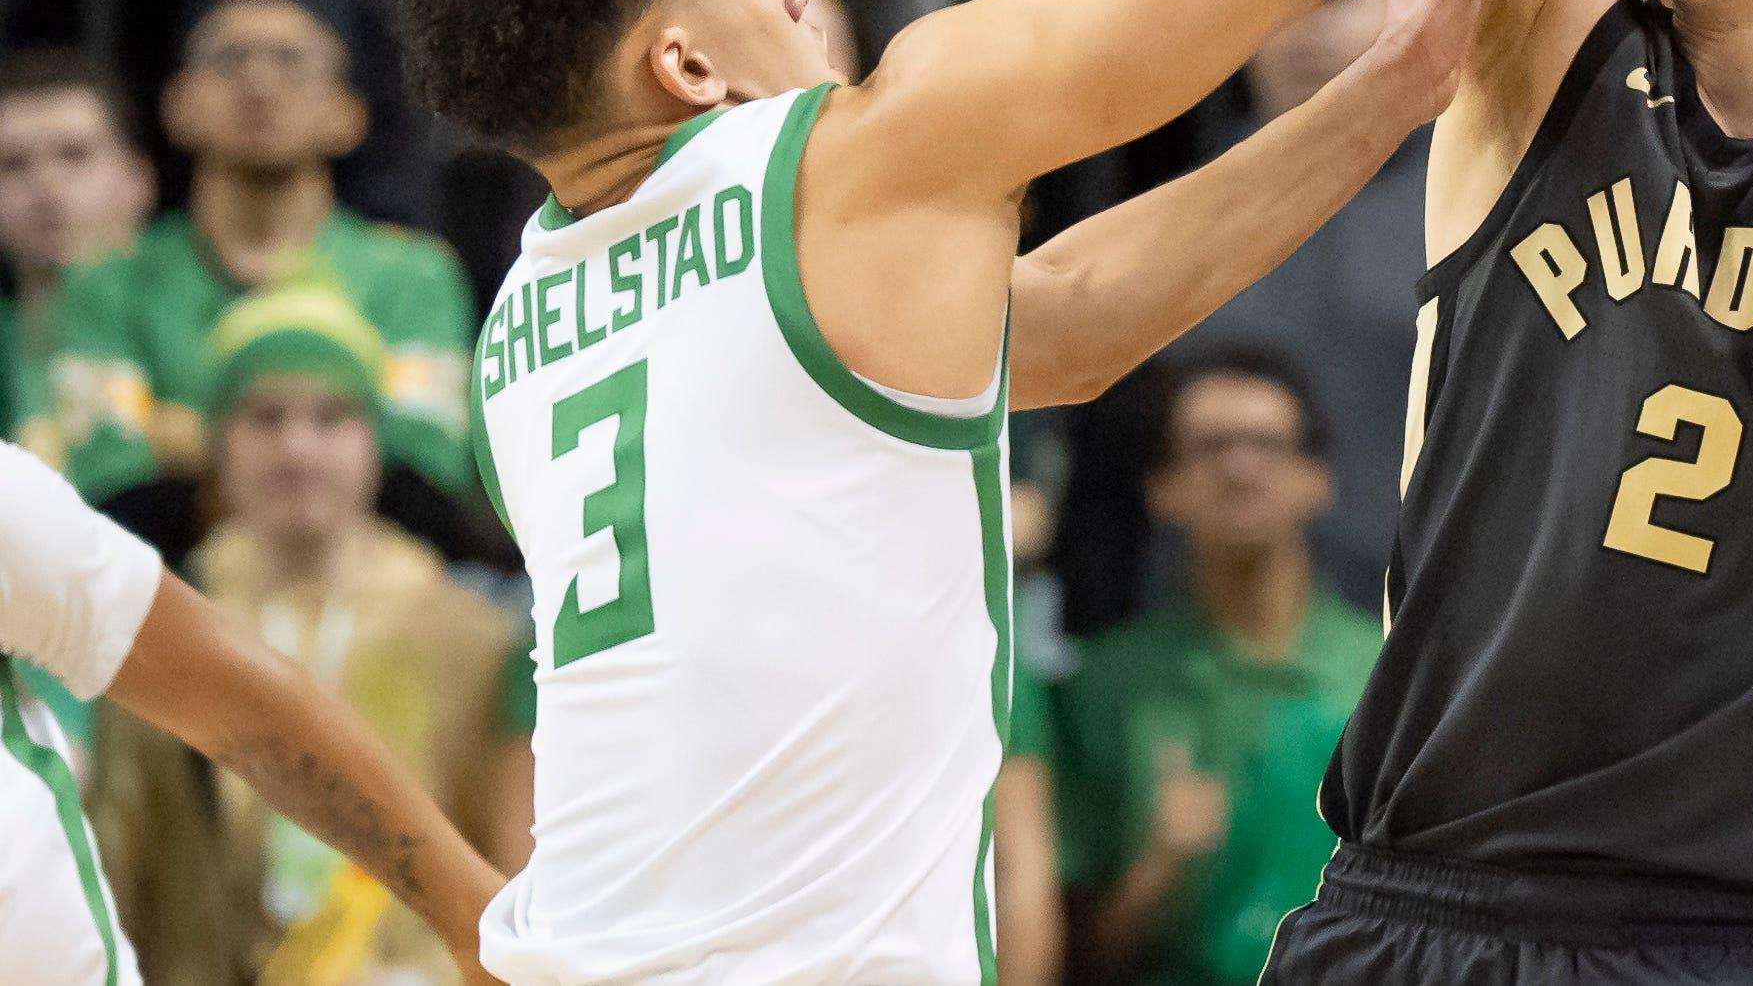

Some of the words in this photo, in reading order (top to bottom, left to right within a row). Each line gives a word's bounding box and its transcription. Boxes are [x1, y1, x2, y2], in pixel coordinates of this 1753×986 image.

[484, 184, 755, 401] SHELSTAD
[551, 357, 655, 670] 3
[1603, 384, 1744, 574] 2
